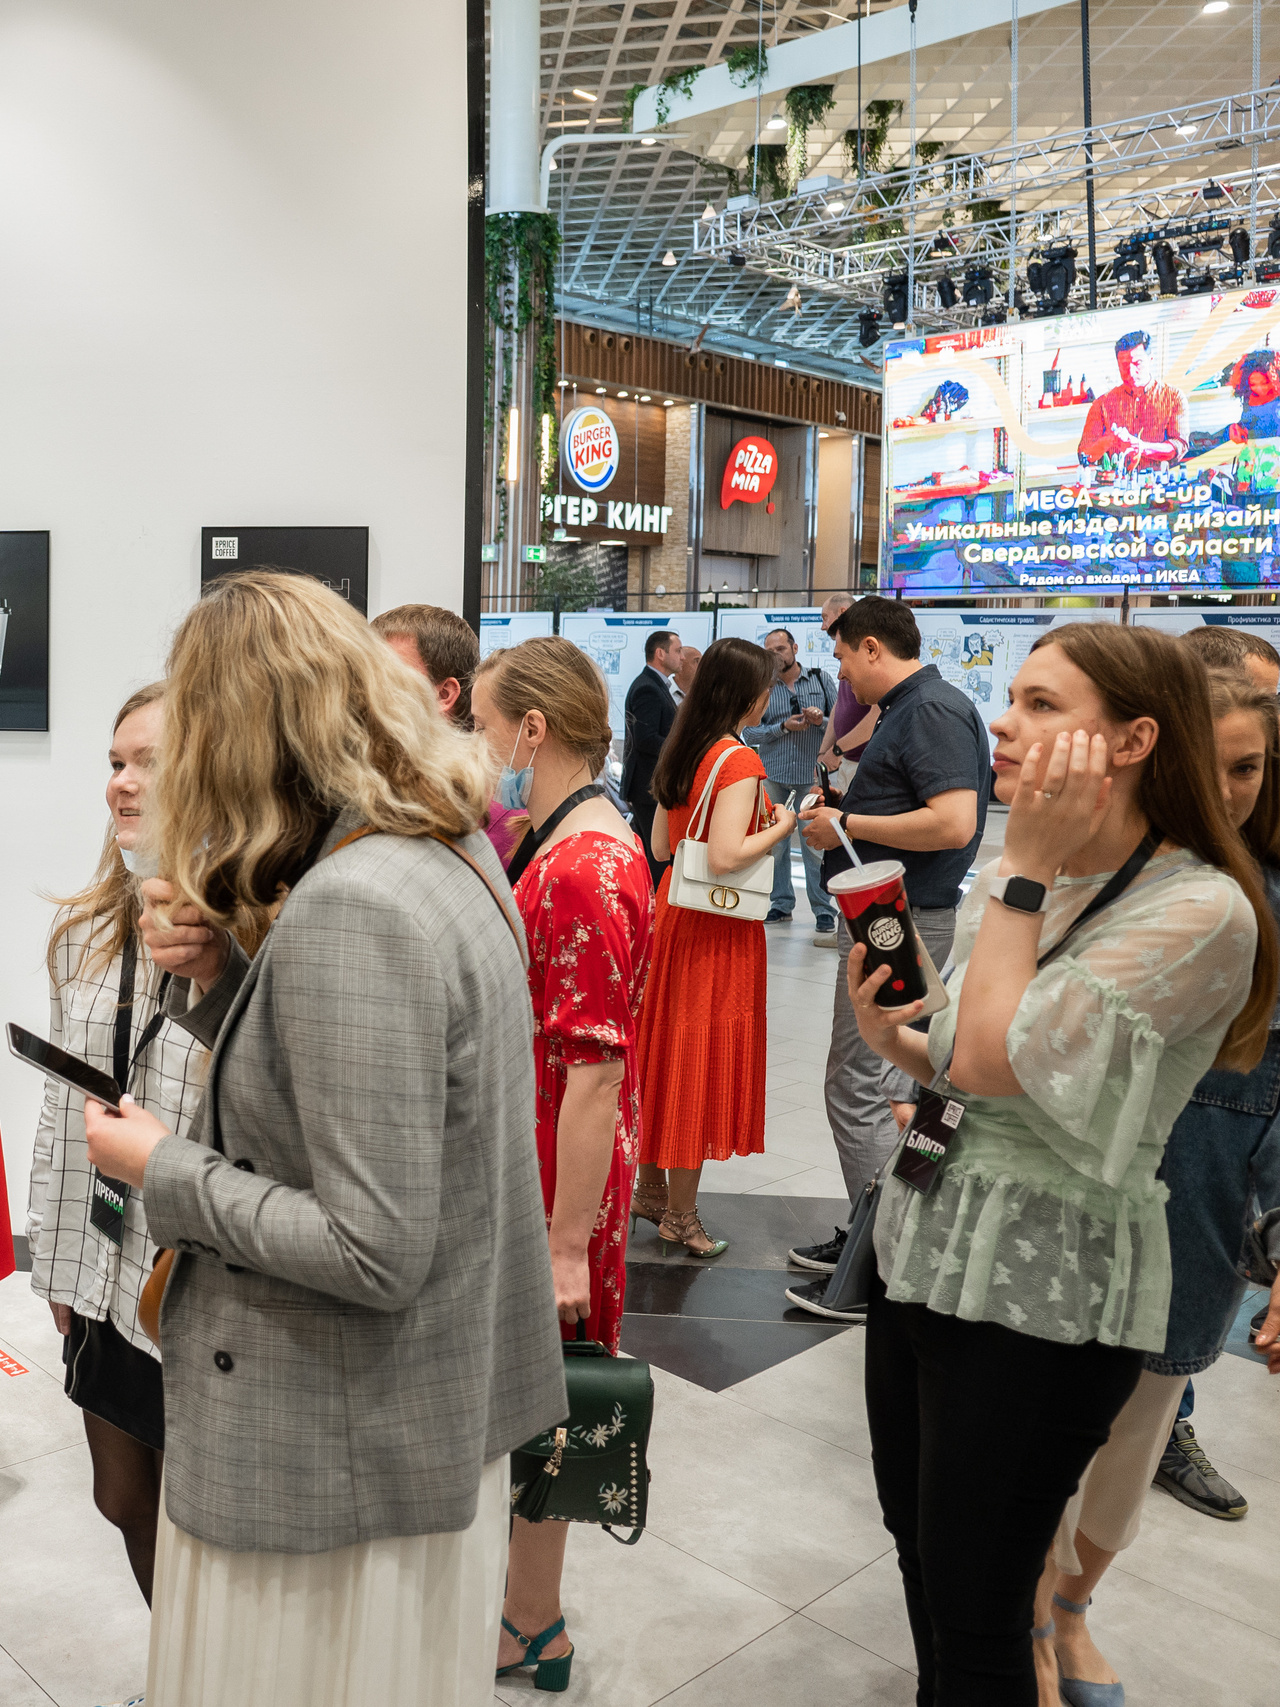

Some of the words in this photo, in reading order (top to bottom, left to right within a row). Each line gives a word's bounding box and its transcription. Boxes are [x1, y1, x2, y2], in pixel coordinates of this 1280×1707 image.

[573, 426, 611, 449] BURGER
[574, 440, 612, 470] KING
[735, 444, 773, 474] PIZZA
[731, 471, 760, 493] MIA
[1019, 489, 1097, 511] MEGA
[1097, 485, 1212, 510] start-up
[607, 500, 673, 534] КИНГ
[907, 520, 1053, 542] Уникальные
[1057, 514, 1168, 538] изделия
[1173, 504, 1280, 533] дизайн
[215, 548, 236, 557] COFFEE
[219, 540, 236, 549] PRICE
[964, 536, 1147, 566] Свердловской
[1153, 536, 1273, 559] области
[1019, 574, 1062, 586] Рядом
[1066, 575, 1084, 585] со
[1086, 574, 1141, 585] входом
[1144, 574, 1153, 584] в
[1155, 569, 1201, 584] ИКЕА
[1227, 616, 1270, 625] Профилактика
[871, 918, 899, 939] BURGER
[875, 923, 902, 946] KING
[906, 1129, 946, 1163] БЛОГЕР
[95, 1178, 124, 1216] ПРЕССА
